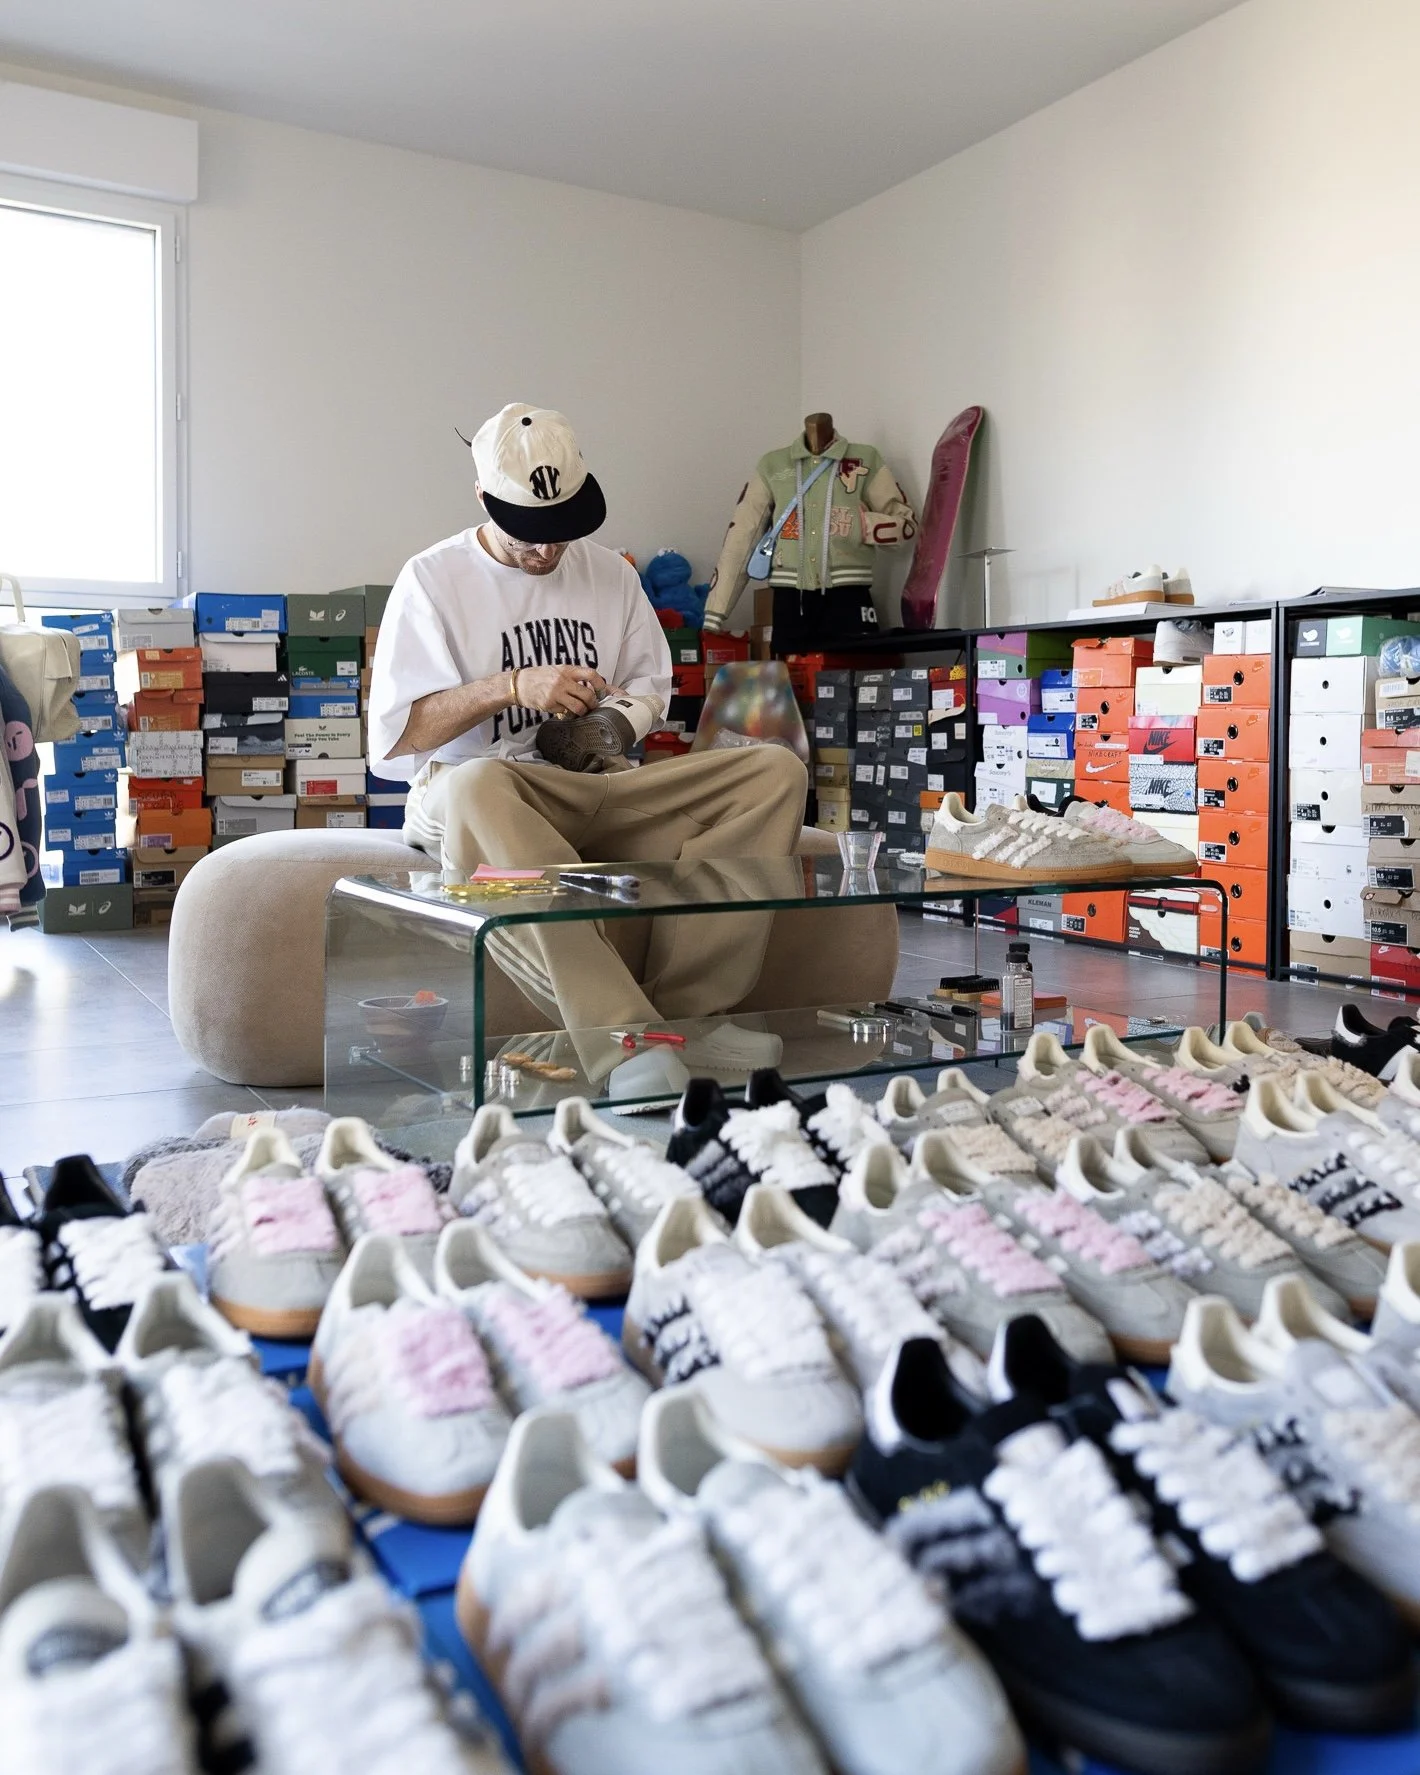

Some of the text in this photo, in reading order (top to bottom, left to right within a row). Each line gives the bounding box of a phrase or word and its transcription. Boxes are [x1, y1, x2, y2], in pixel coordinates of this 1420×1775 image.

[529, 465, 561, 500] NY
[501, 617, 598, 672] ALWAYS
[1148, 731, 1170, 745] NIKE
[1147, 779, 1170, 795] NIKE
[1027, 898, 1052, 908] KLEMAN
